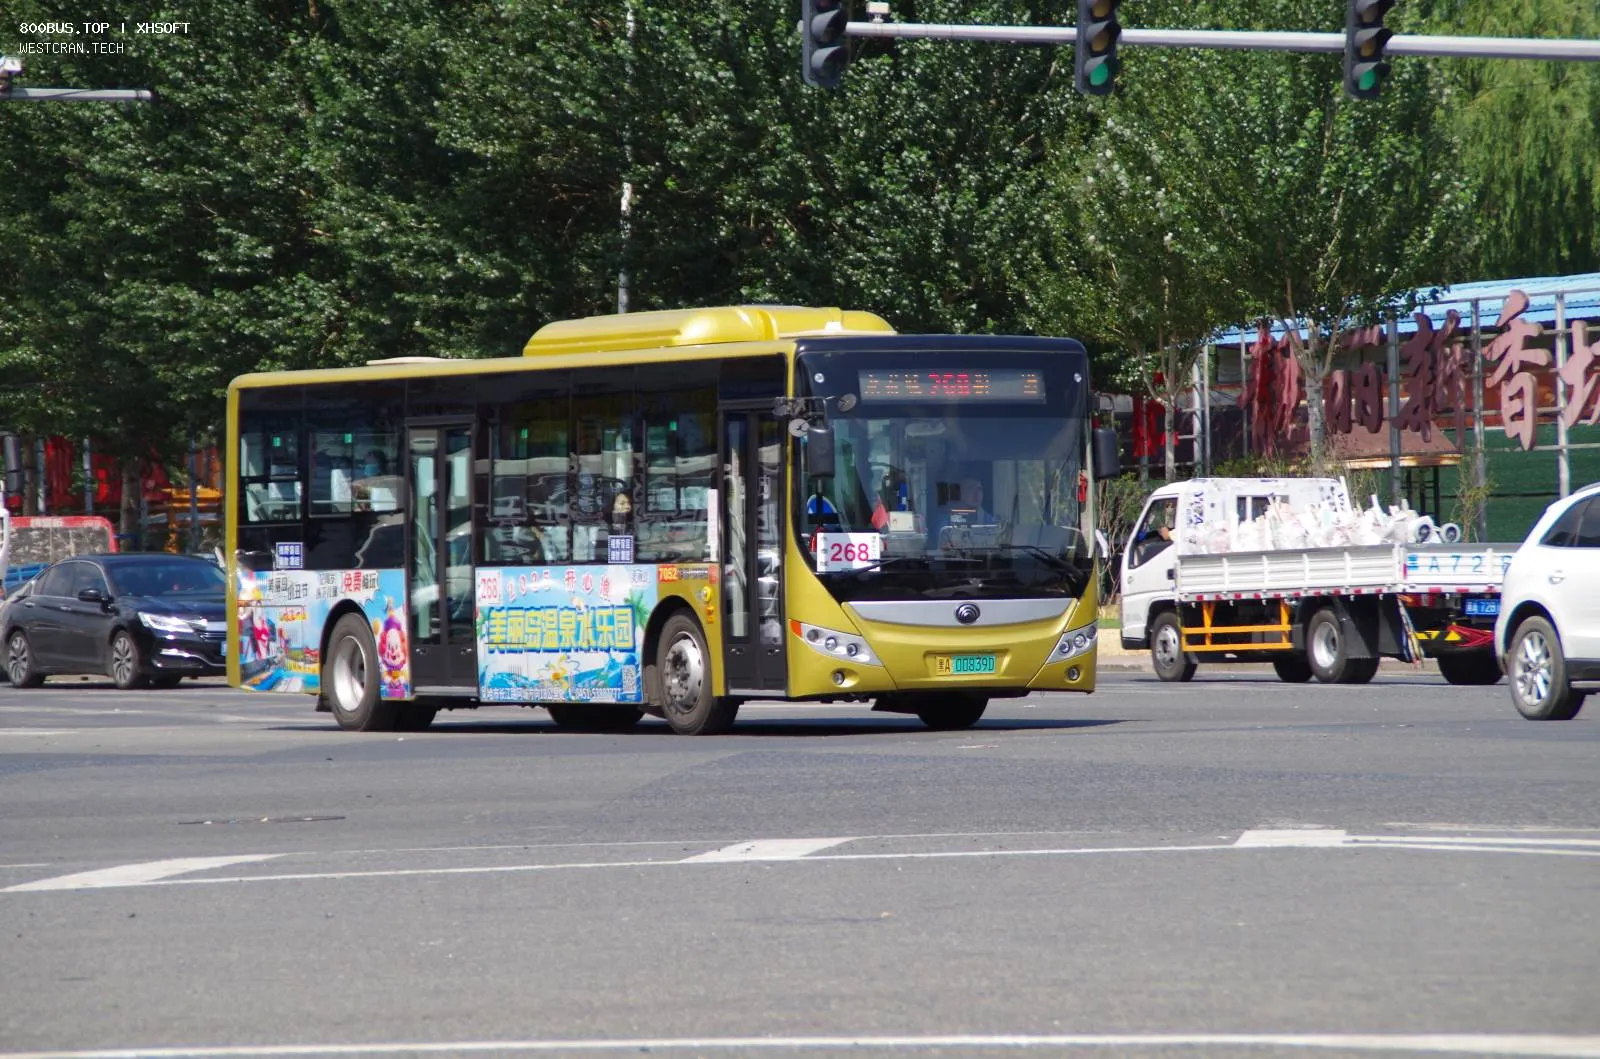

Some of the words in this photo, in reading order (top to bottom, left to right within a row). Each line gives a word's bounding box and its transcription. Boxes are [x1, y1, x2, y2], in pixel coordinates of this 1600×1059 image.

[831, 543, 869, 562] 268
[659, 567, 678, 580] 7052
[480, 577, 498, 599] 268
[489, 607, 635, 653] 美丽岛温泉水乐园
